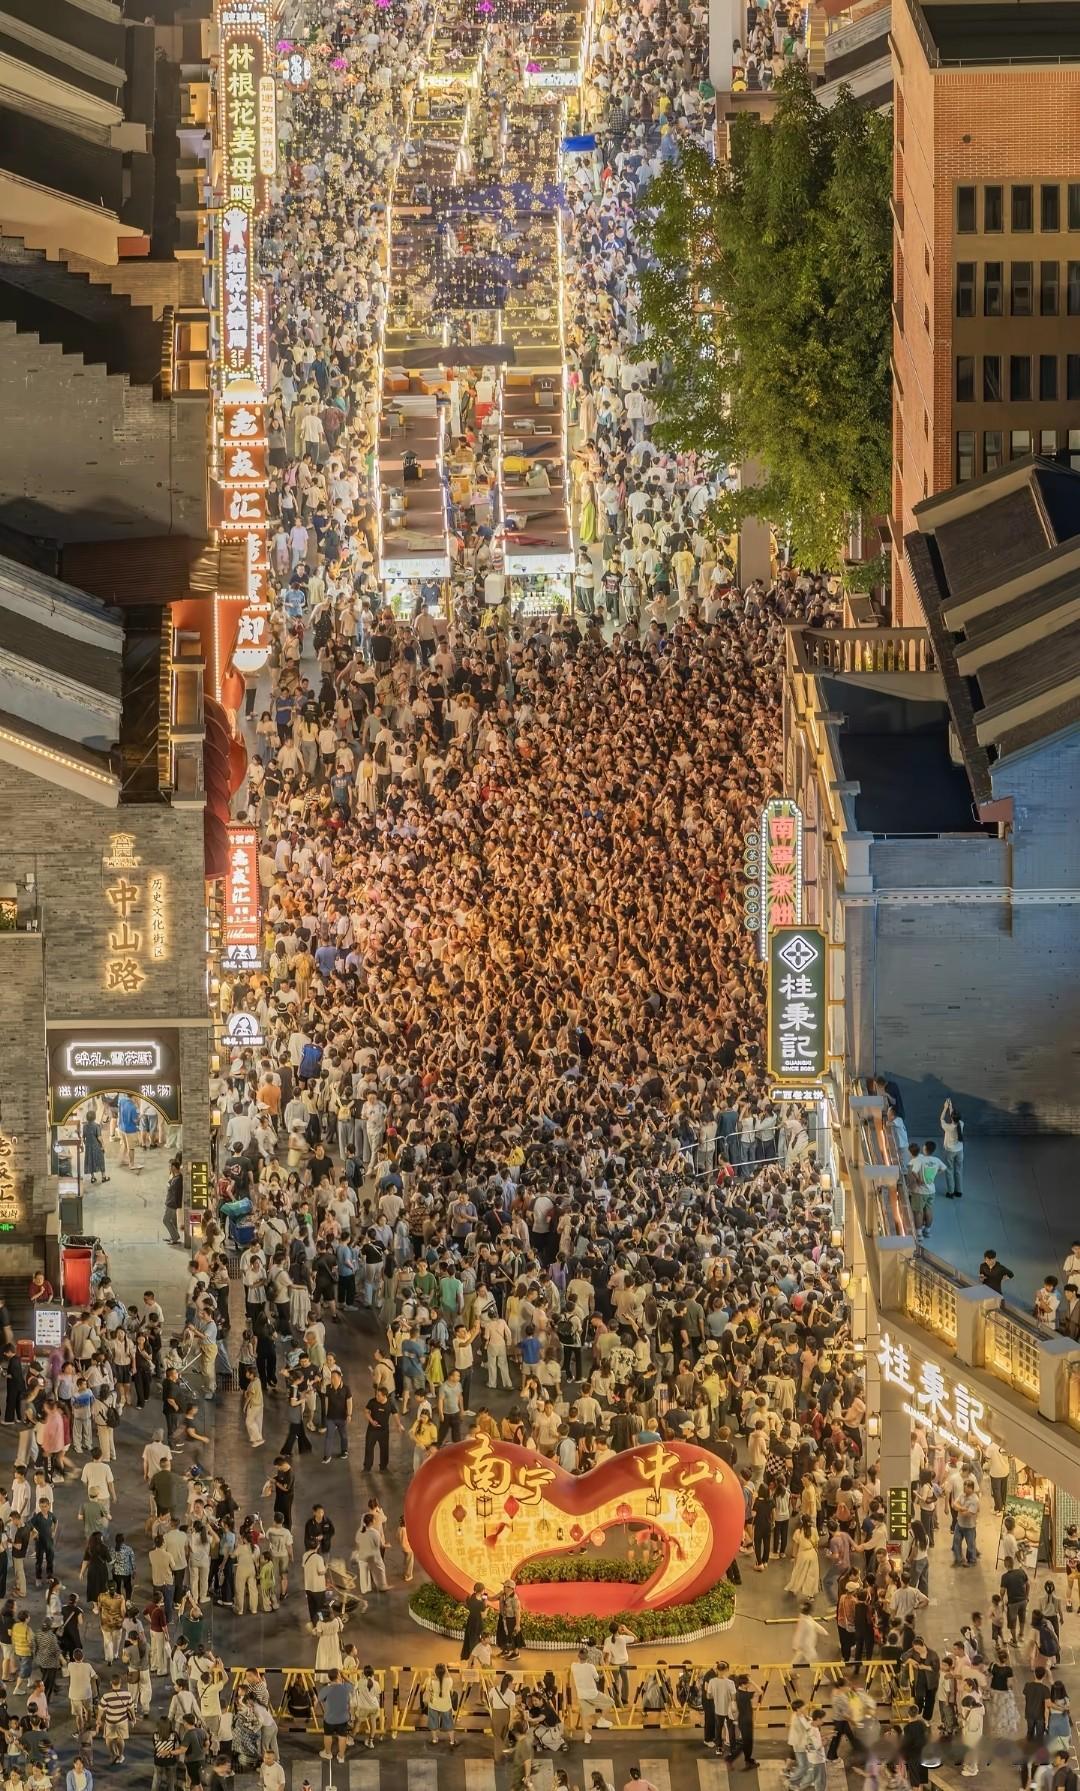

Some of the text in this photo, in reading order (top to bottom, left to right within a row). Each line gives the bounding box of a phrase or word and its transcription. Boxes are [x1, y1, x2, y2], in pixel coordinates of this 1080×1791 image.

[226, 42, 257, 208] 林根花姜母鸭
[230, 349, 245, 358] 2F
[231, 359, 245, 368] 3F
[107, 879, 145, 992] 中山路
[152, 878, 165, 958] 历史文化街区
[462, 1432, 557, 1505] 南宁
